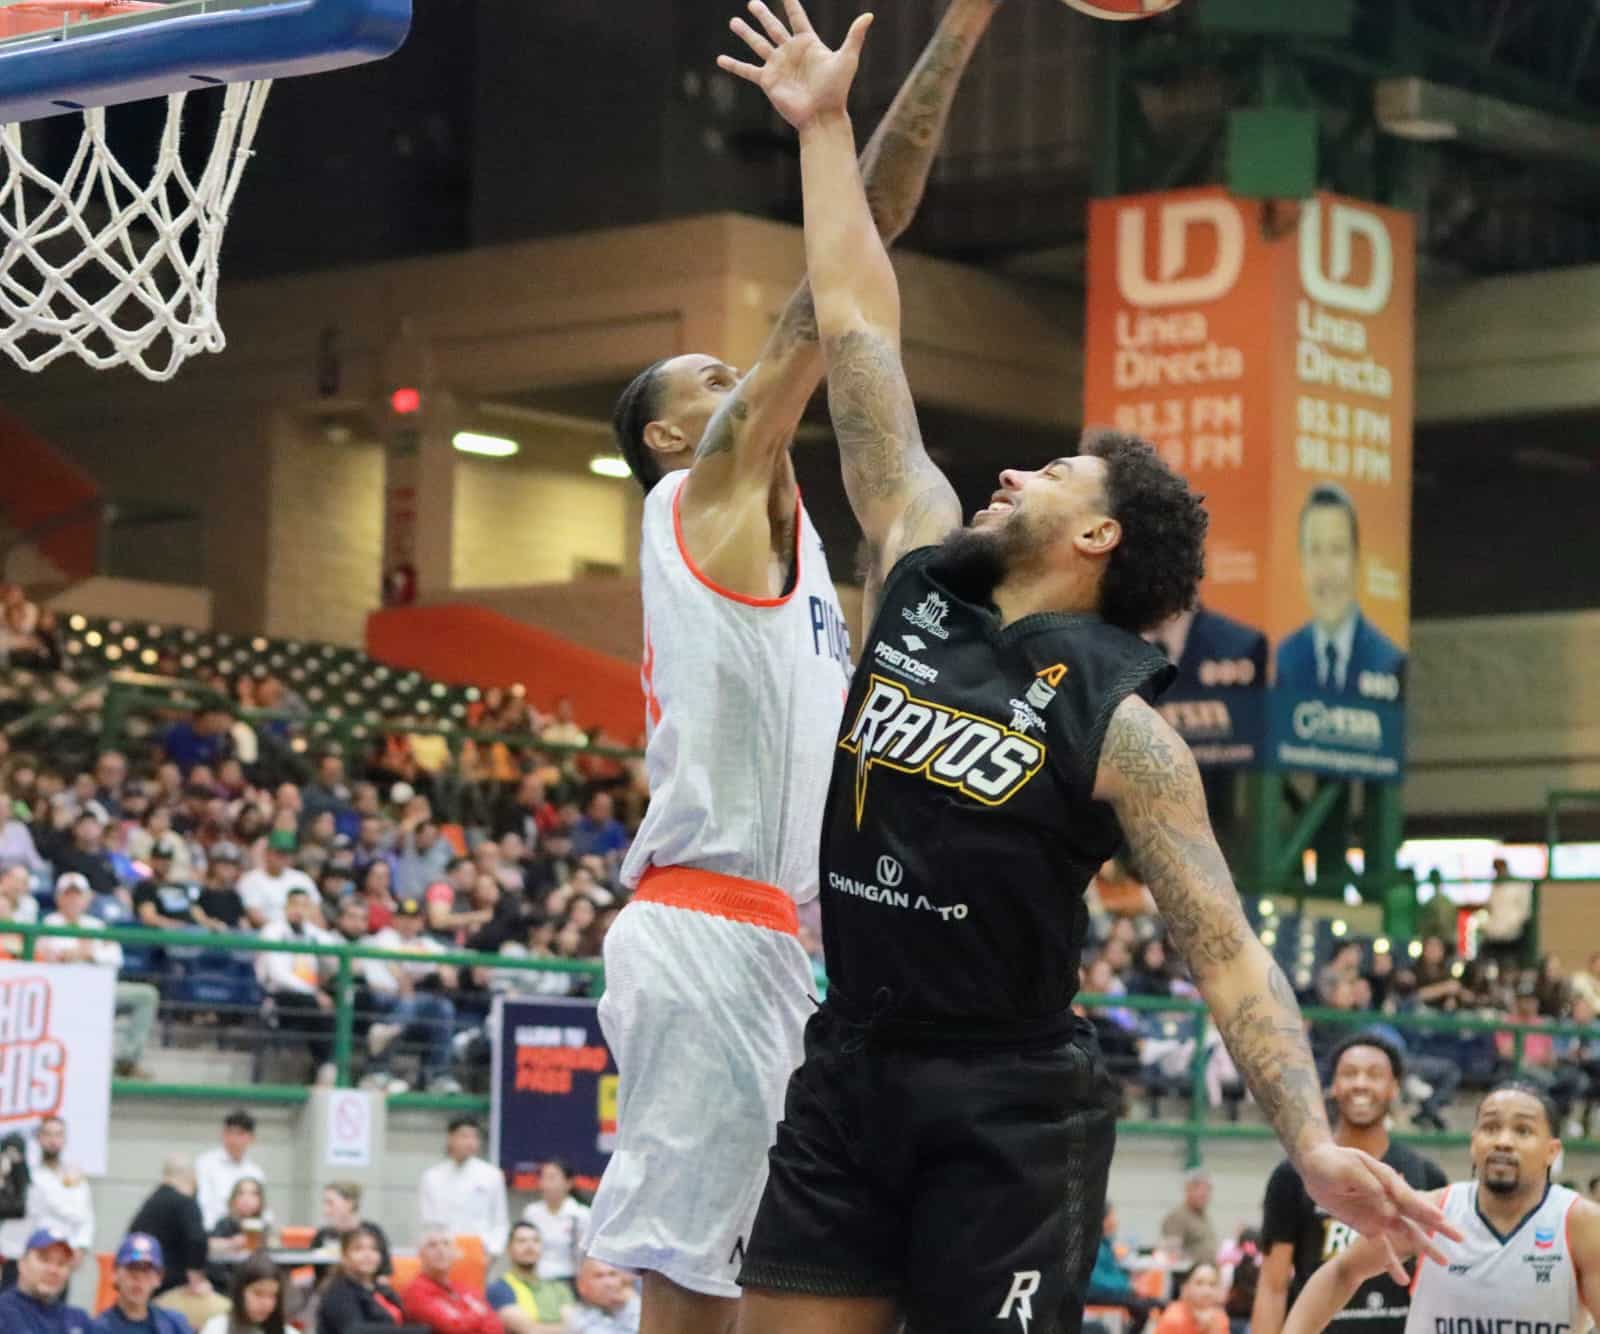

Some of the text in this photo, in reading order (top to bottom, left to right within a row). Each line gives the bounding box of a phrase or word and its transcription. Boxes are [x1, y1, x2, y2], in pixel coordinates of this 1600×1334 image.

[1114, 342, 1245, 391] Directa
[1297, 339, 1393, 399] Directa
[1192, 394, 1243, 431] FM
[1354, 408, 1392, 447] FM
[1353, 447, 1392, 486] FM
[839, 673, 1047, 806] RAYOS
[828, 871, 909, 909] CHANGAN
